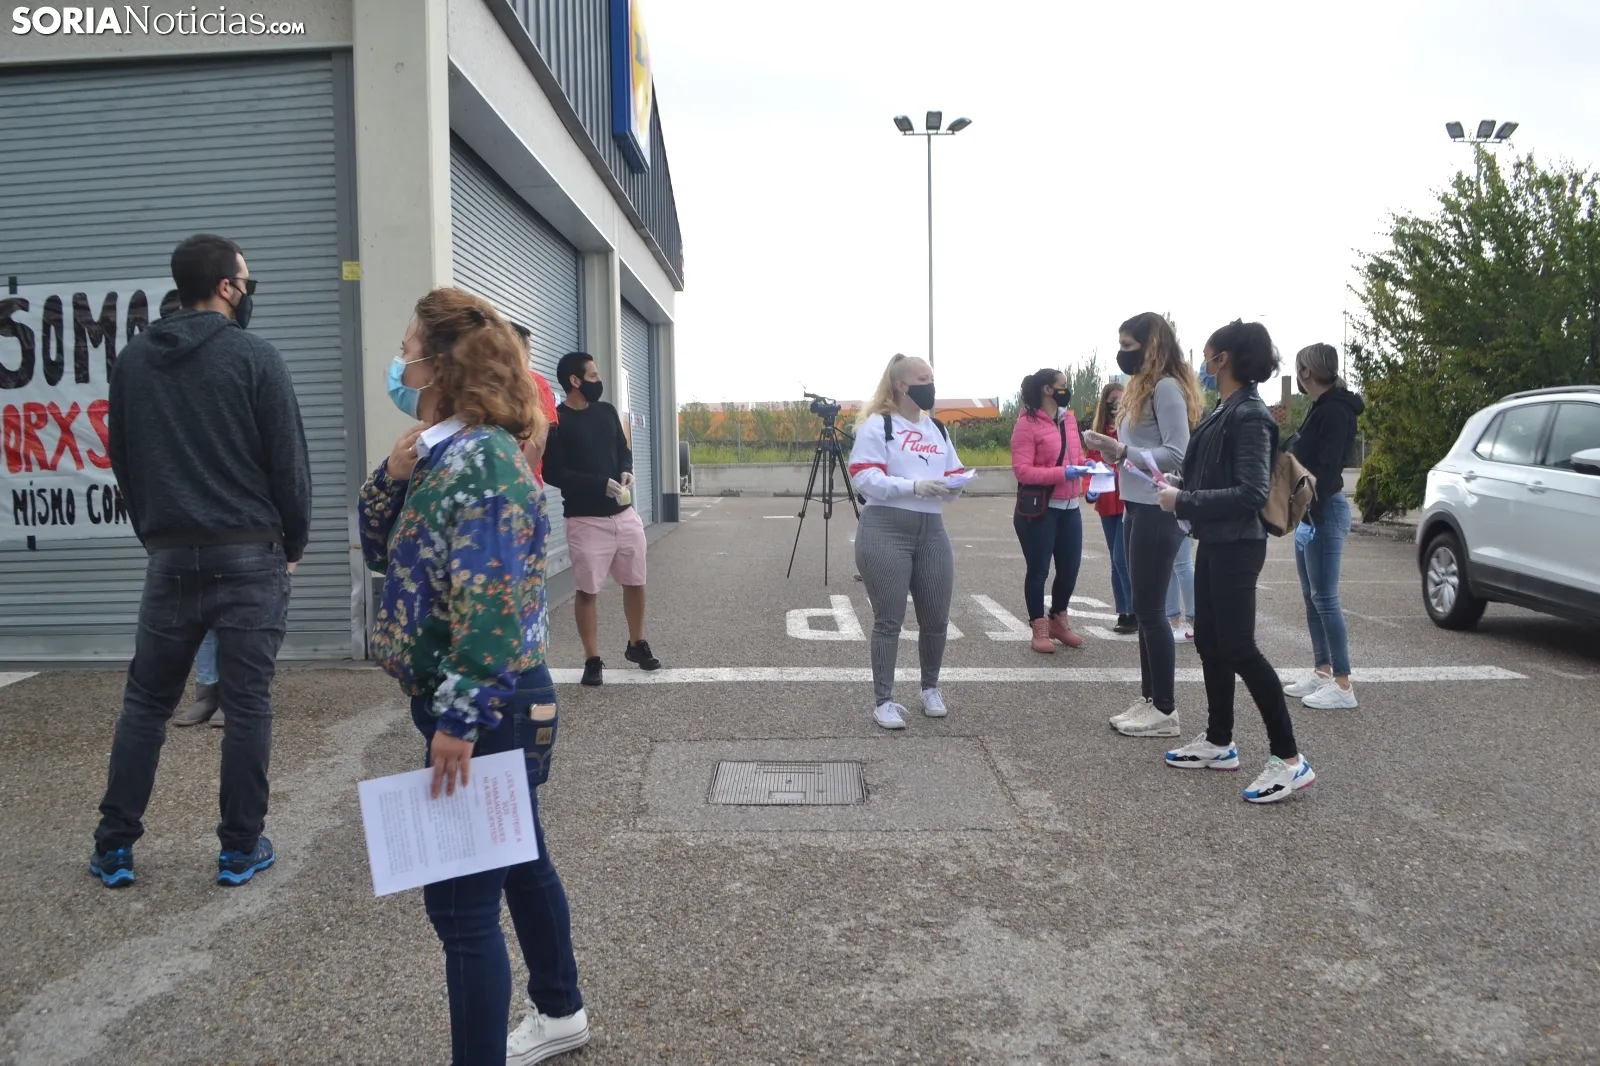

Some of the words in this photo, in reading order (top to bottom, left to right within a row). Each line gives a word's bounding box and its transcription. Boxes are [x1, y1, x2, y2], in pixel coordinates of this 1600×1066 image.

[0, 289, 181, 389] SOM
[0, 399, 112, 474] ORXS
[896, 430, 944, 455] Puma
